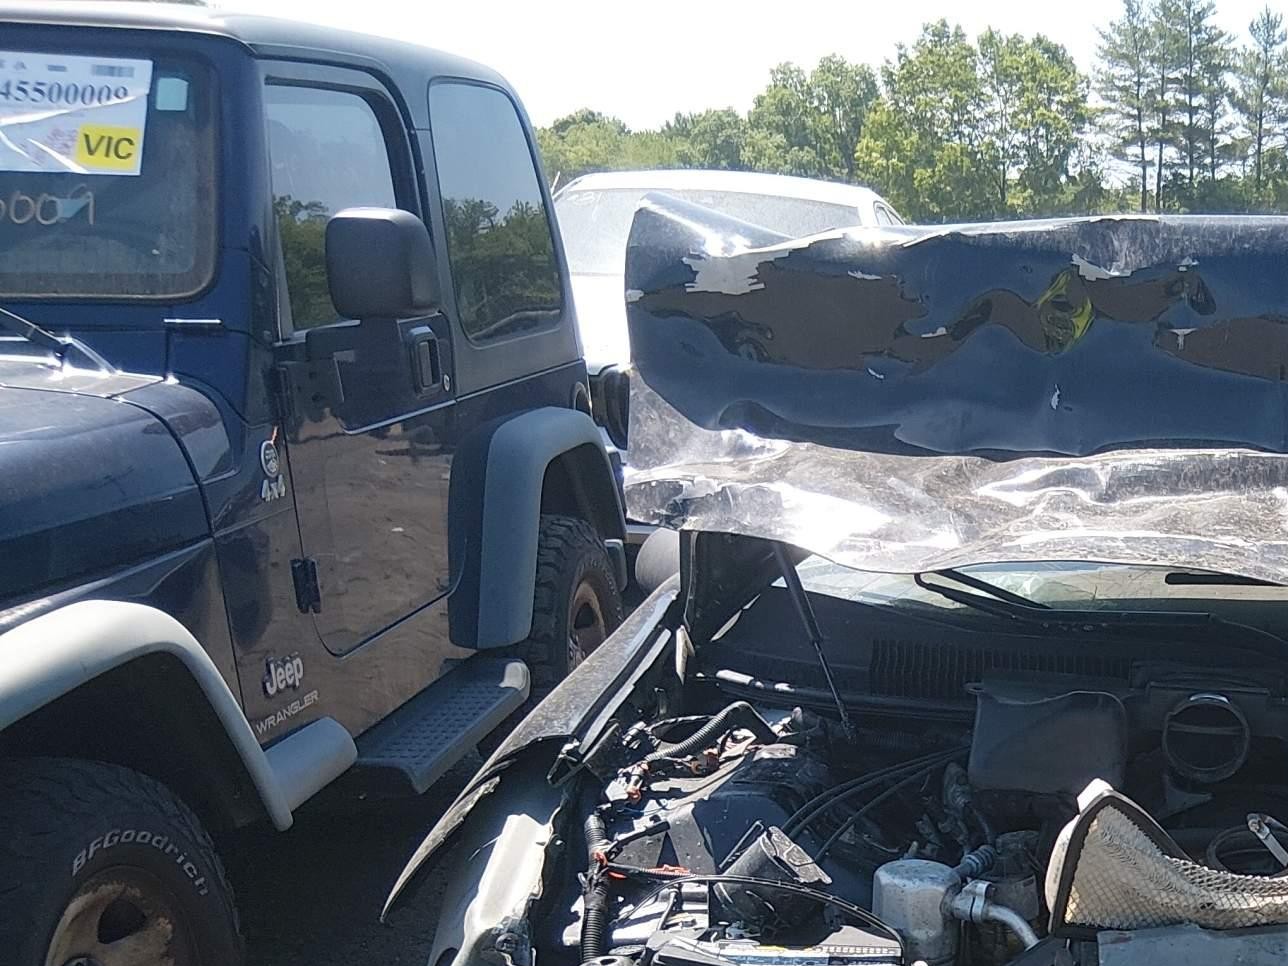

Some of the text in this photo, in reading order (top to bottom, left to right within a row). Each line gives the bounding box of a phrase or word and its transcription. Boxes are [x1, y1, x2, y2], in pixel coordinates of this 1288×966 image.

[83, 133, 134, 160] VIC
[261, 474, 286, 502] 4x4
[265, 656, 304, 695] Jeep
[256, 690, 319, 734] WRANGLER
[72, 829, 208, 896] BFGoodrich
